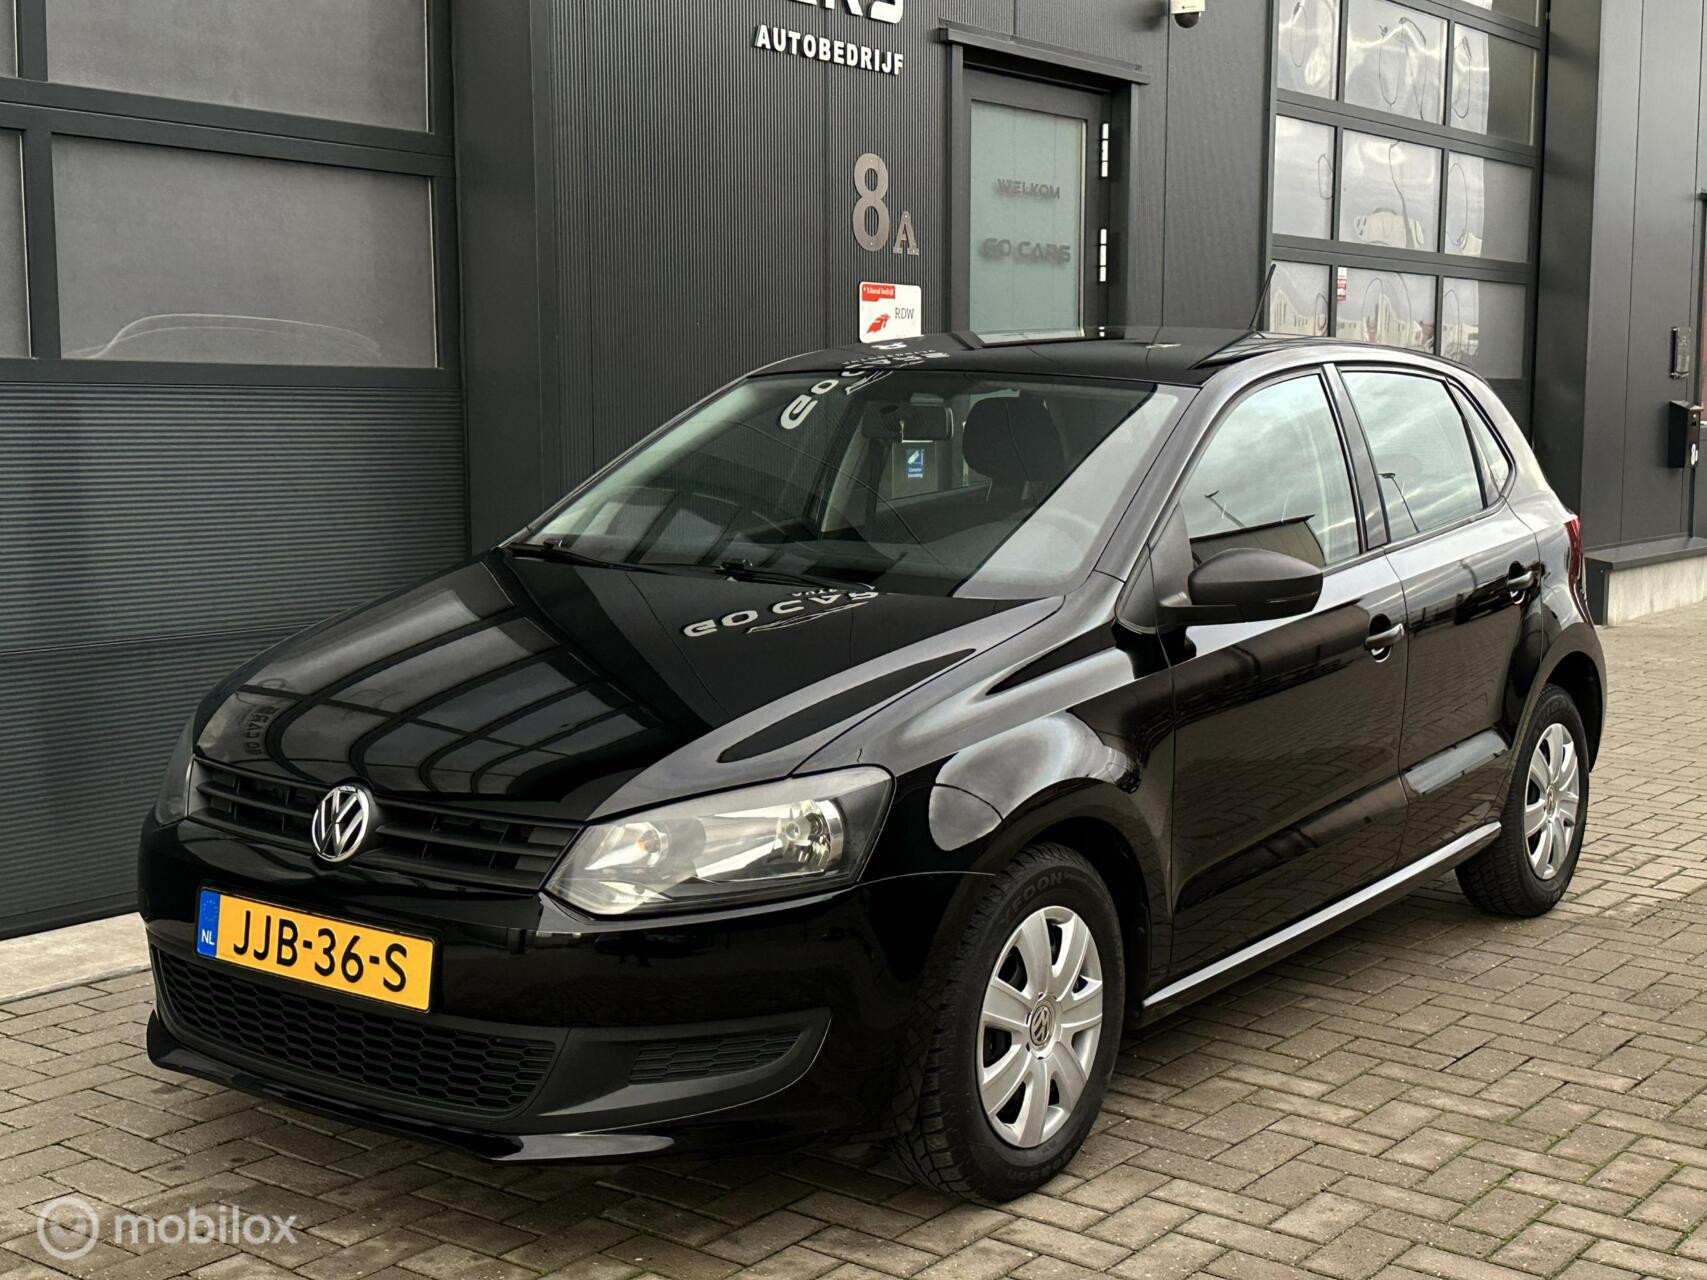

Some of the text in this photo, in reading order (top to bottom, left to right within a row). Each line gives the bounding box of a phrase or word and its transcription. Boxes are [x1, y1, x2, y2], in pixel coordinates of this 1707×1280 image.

[755, 25, 904, 75] AUTOBEDRIJF
[994, 178, 1061, 200] WELKOM
[853, 153, 920, 255] 8A
[1018, 241, 1071, 263] CARS
[895, 307, 915, 320] RDW
[201, 928, 215, 946] NL
[233, 910, 407, 993] JJB-36-S
